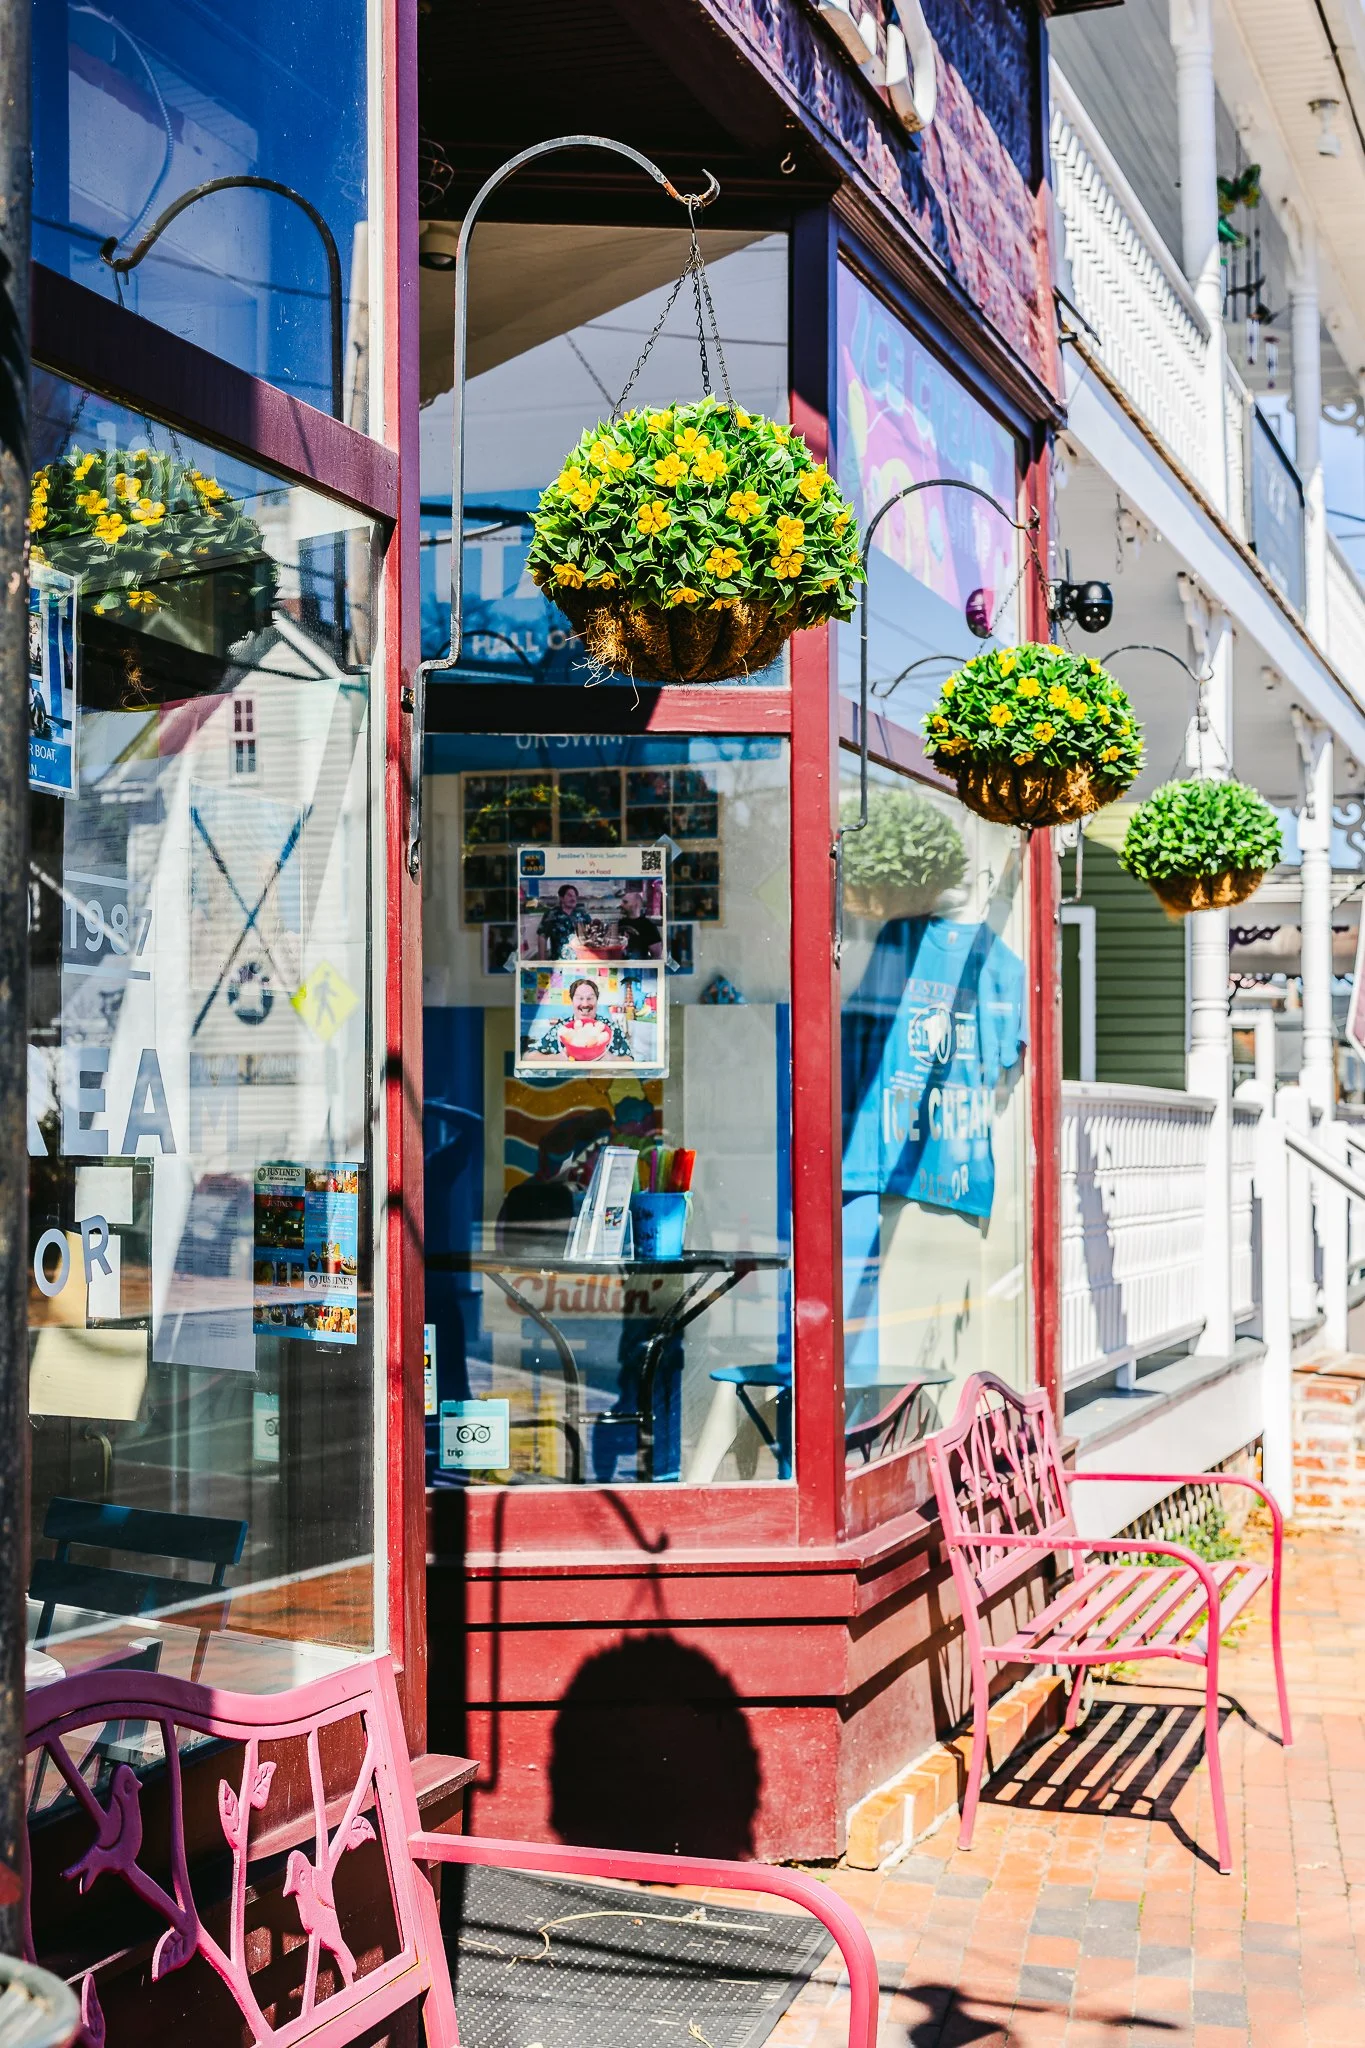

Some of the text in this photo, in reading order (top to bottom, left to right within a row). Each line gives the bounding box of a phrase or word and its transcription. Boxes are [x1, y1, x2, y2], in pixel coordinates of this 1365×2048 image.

[472, 631, 540, 655] HALL
[35, 744, 58, 764] BOAT,
[65, 899, 152, 956] 1987
[883, 1087, 996, 1145] ICE CREAM
[266, 1167, 301, 1177] JUSTINE'S
